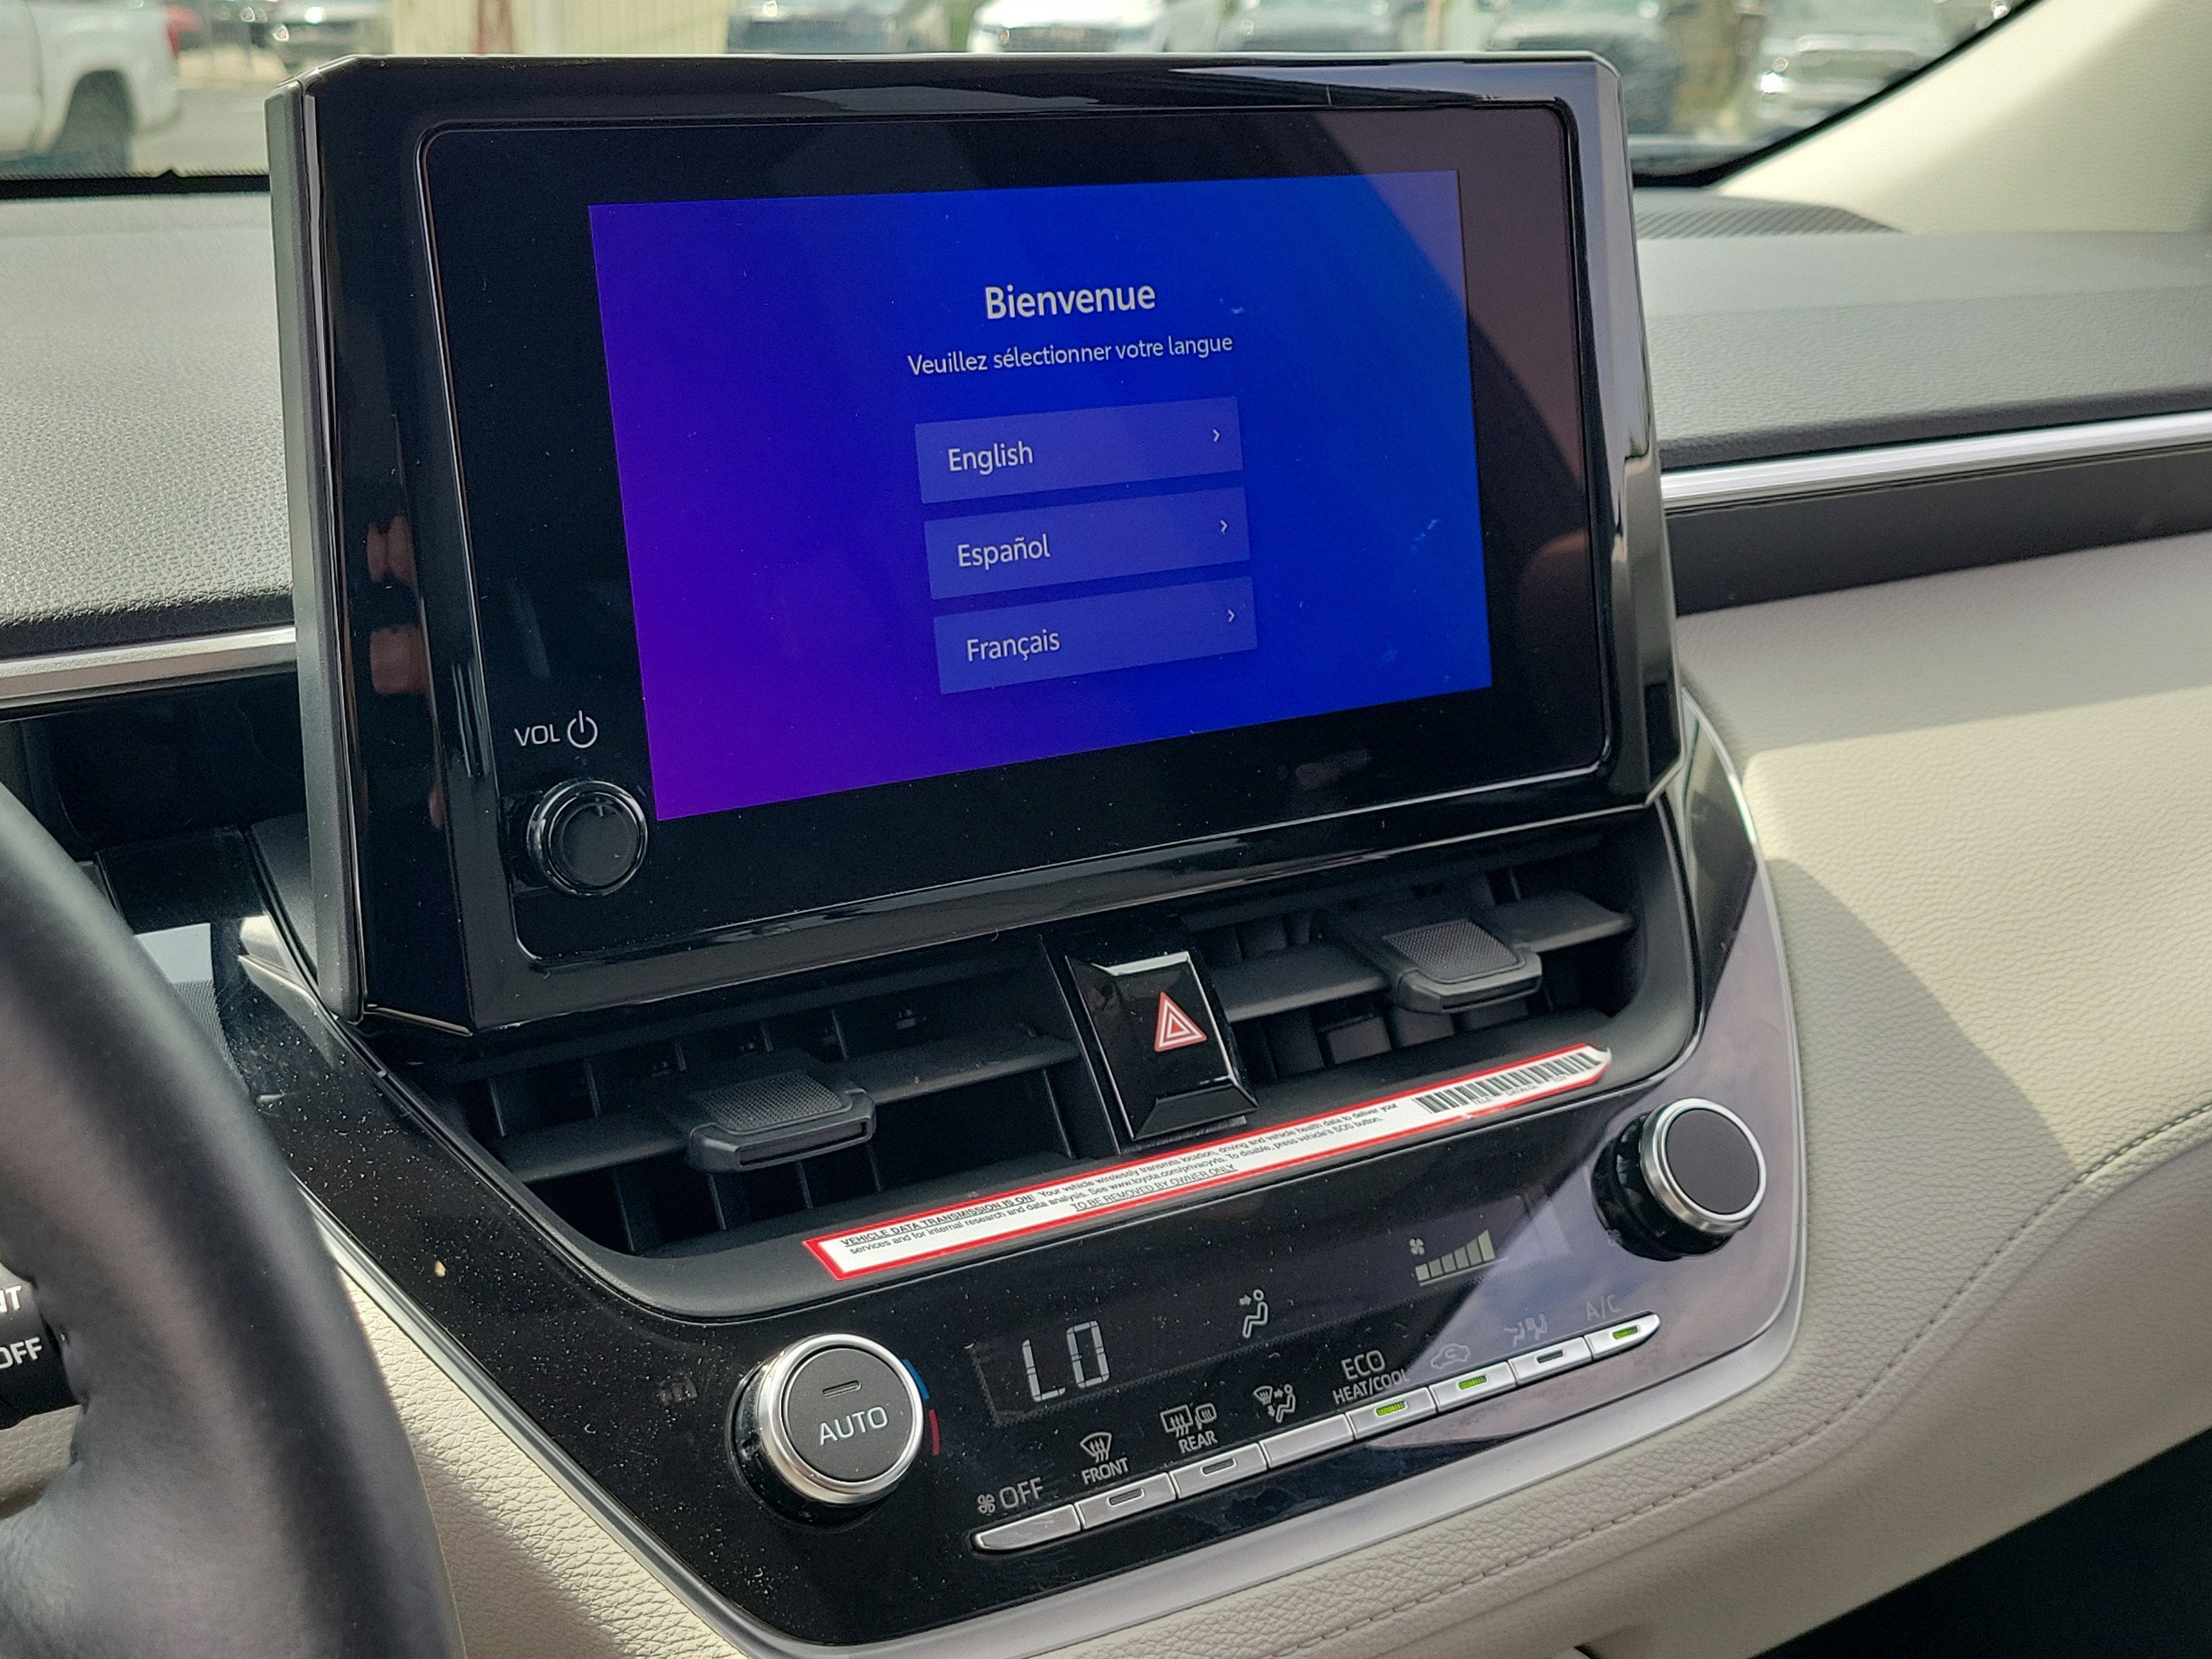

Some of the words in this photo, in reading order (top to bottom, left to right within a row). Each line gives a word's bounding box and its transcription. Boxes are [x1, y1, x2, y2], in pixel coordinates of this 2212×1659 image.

[984, 284, 1156, 319] Bienvenue
[907, 351, 988, 376] Veuillez
[993, 344, 1111, 369] sélectionner
[1115, 342, 1164, 359] votre
[1167, 335, 1233, 362] langue
[947, 441, 1034, 475] English
[957, 533, 1051, 570] Español
[966, 629, 1060, 662] Français
[514, 724, 560, 746] VOL
[840, 1229, 889, 1246] VEHICLE
[890, 1222, 922, 1234] DATA
[920, 1201, 1002, 1226] TRANSMISSION
[1002, 1199, 1014, 1207] IS
[1037, 1188, 1061, 1198] Your
[1062, 1180, 1094, 1192] vehicle
[1095, 1167, 1139, 1184] wirelessly
[1138, 1159, 1181, 1173] transmits
[1218, 1143, 1249, 1153] driving
[1248, 1137, 1266, 1146] and
[1265, 1130, 1296, 1141] vehicle
[1294, 1122, 1323, 1133] health
[1323, 1118, 1343, 1126] data
[850, 1240, 891, 1254] services
[892, 1234, 912, 1244] and
[926, 1221, 965, 1235] internal
[964, 1211, 1007, 1226] research
[1006, 1206, 1026, 1215] and
[1026, 1201, 1049, 1210] data
[1048, 1191, 1089, 1205] analysis.
[1088, 1187, 1109, 1195] See
[1273, 1138, 1298, 1149] press
[1332, 1123, 1355, 1132] SOS
[1070, 1203, 1087, 1212] TO
[1087, 1198, 1102, 1206] BE
[1103, 1184, 1154, 1203] REMOVED
[1153, 1180, 1170, 1189] BY
[1169, 1170, 1209, 1185] OWNER
[1208, 1163, 1235, 1175] ONLY
[1585, 1294, 1620, 1318] A/C
[0, 1336, 42, 1368] OFF
[1341, 1350, 1386, 1379] ECO
[1332, 1369, 1410, 1404] HEAT/COOL
[820, 1406, 888, 1444] AUTO
[1177, 1430, 1217, 1454] REAR
[1081, 1457, 1129, 1484] FRONT
[999, 1477, 1045, 1510] OFF
